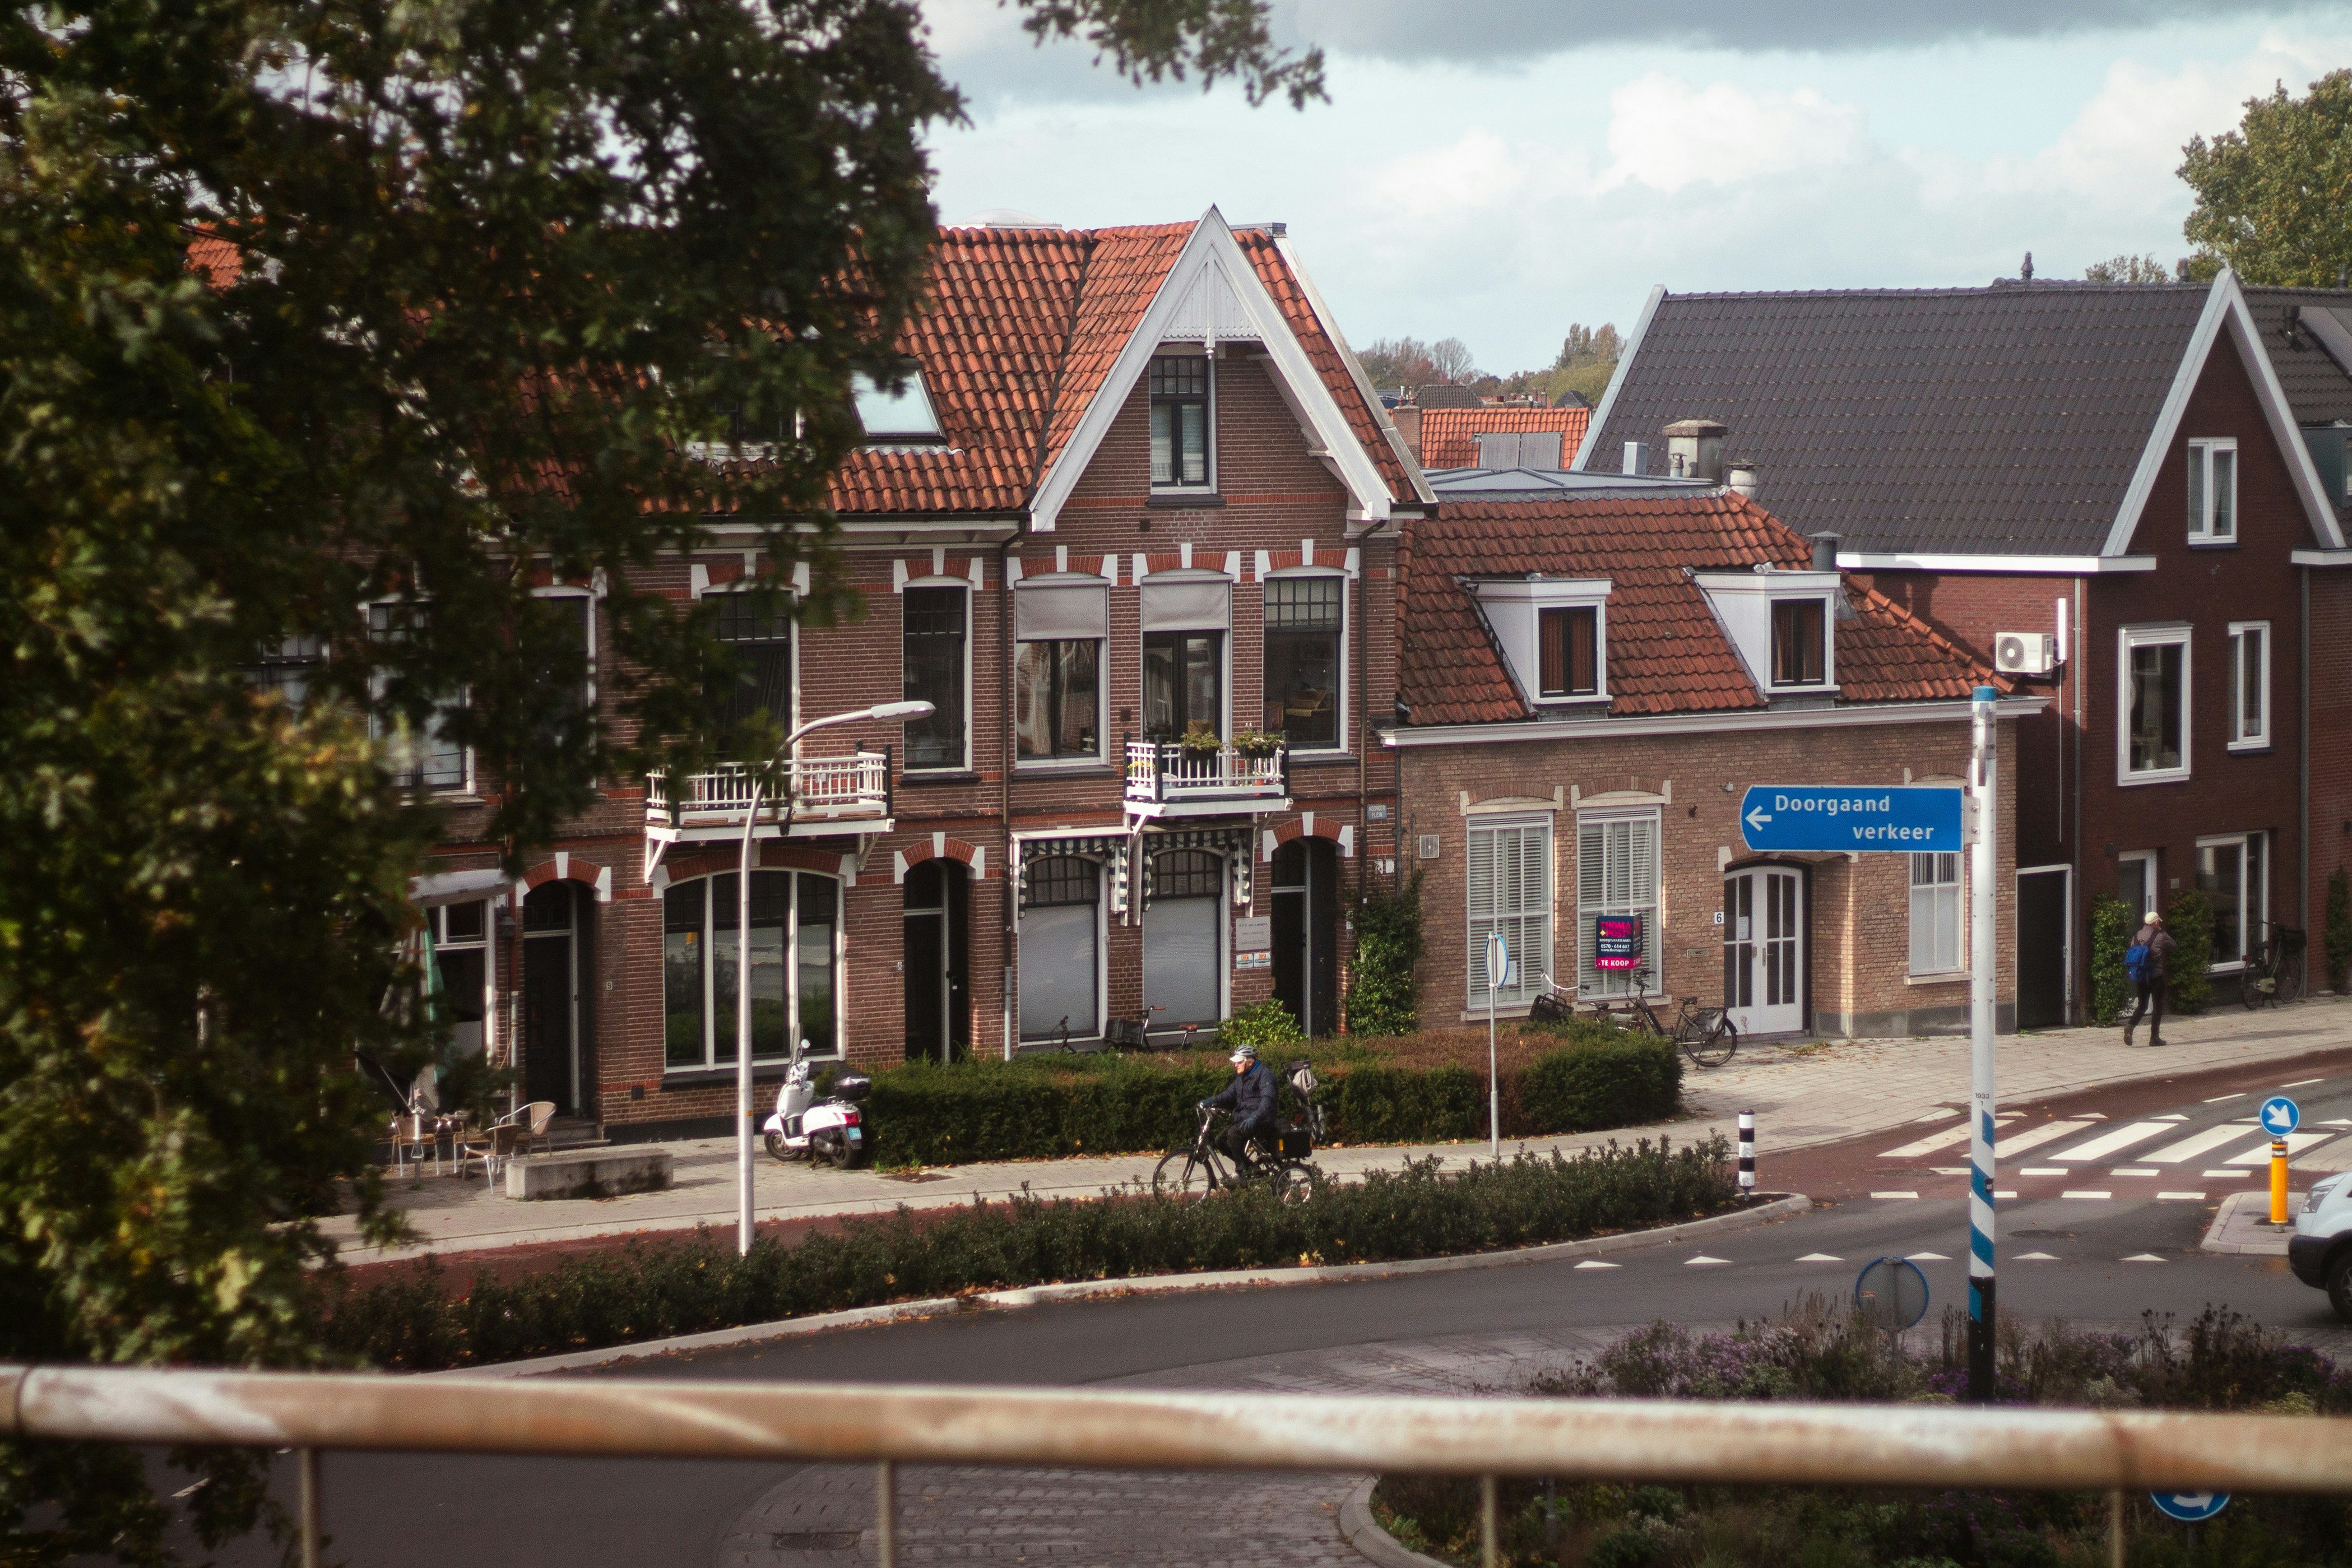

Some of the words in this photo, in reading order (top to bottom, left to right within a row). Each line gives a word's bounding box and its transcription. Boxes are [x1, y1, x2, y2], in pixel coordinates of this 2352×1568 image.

[1775, 795, 1890, 816] Doorgaand
[1853, 823, 1935, 840] verkeer
[1717, 913, 1722, 923] 6
[1600, 921, 1631, 930] THOMA
